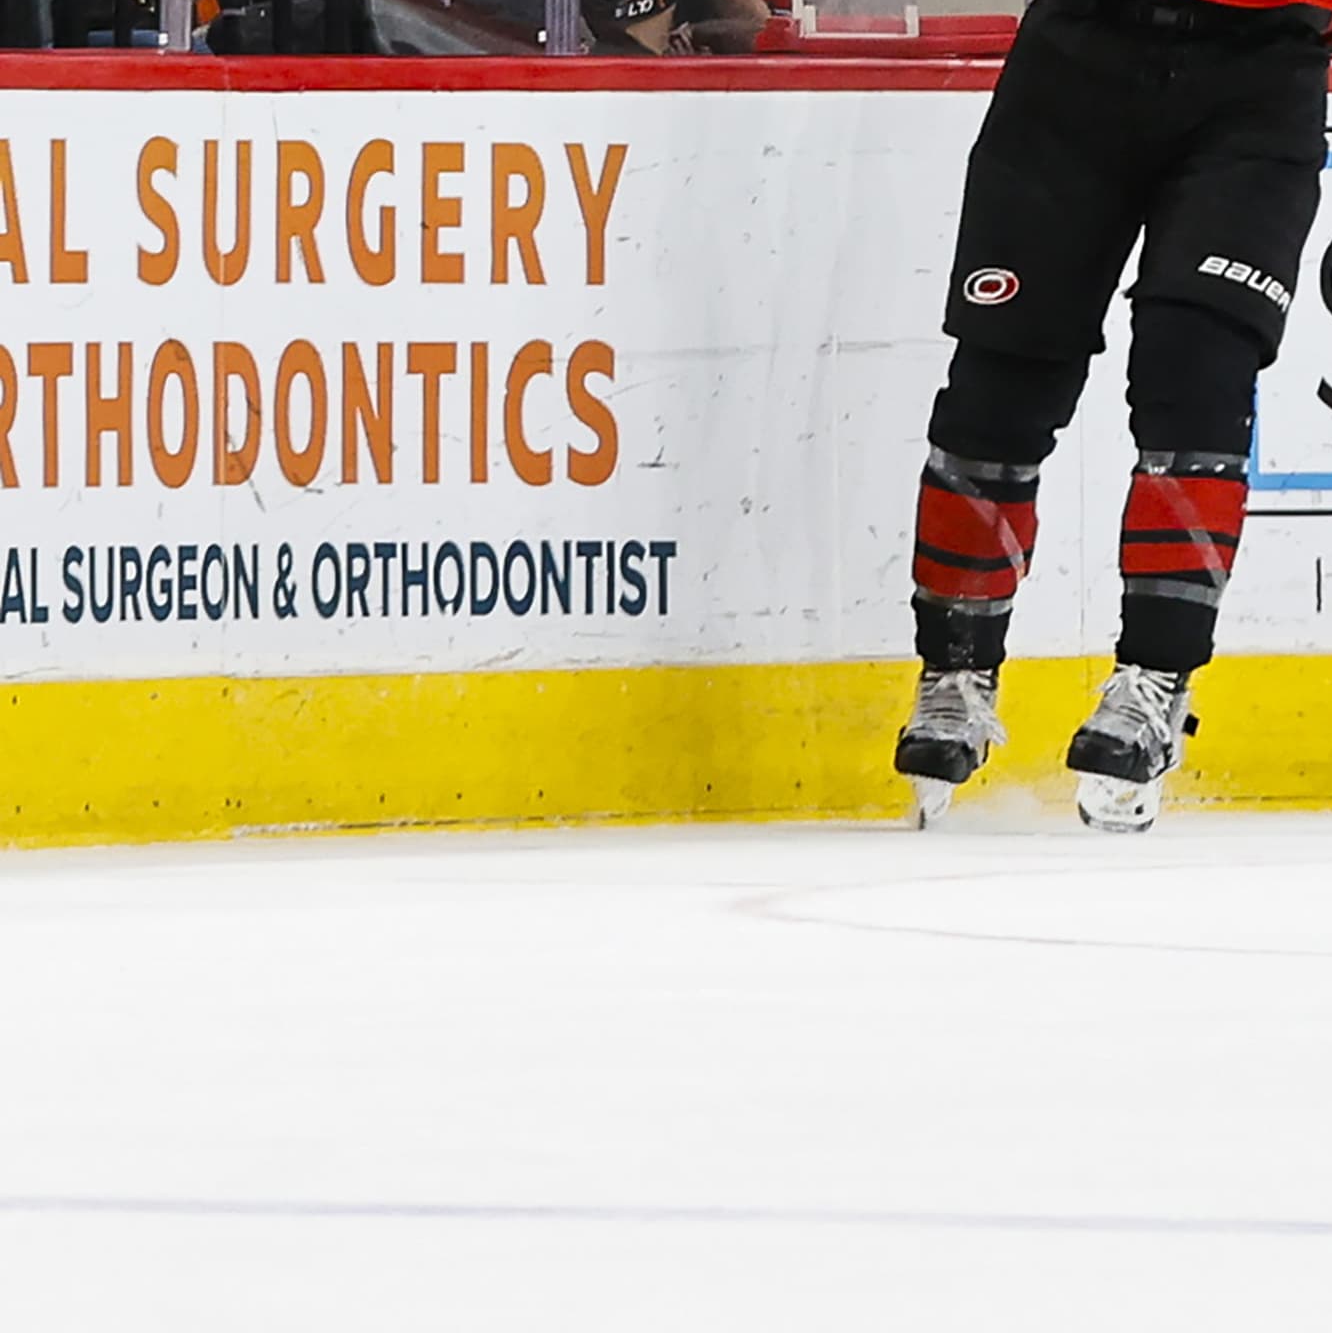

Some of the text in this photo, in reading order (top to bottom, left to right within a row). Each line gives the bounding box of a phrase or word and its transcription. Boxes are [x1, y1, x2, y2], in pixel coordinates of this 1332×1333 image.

[138, 136, 627, 287] SURGERY
[62, 543, 259, 624] SURGEON
[273, 542, 298, 619] &
[311, 539, 677, 619] ORTHODONTIST
